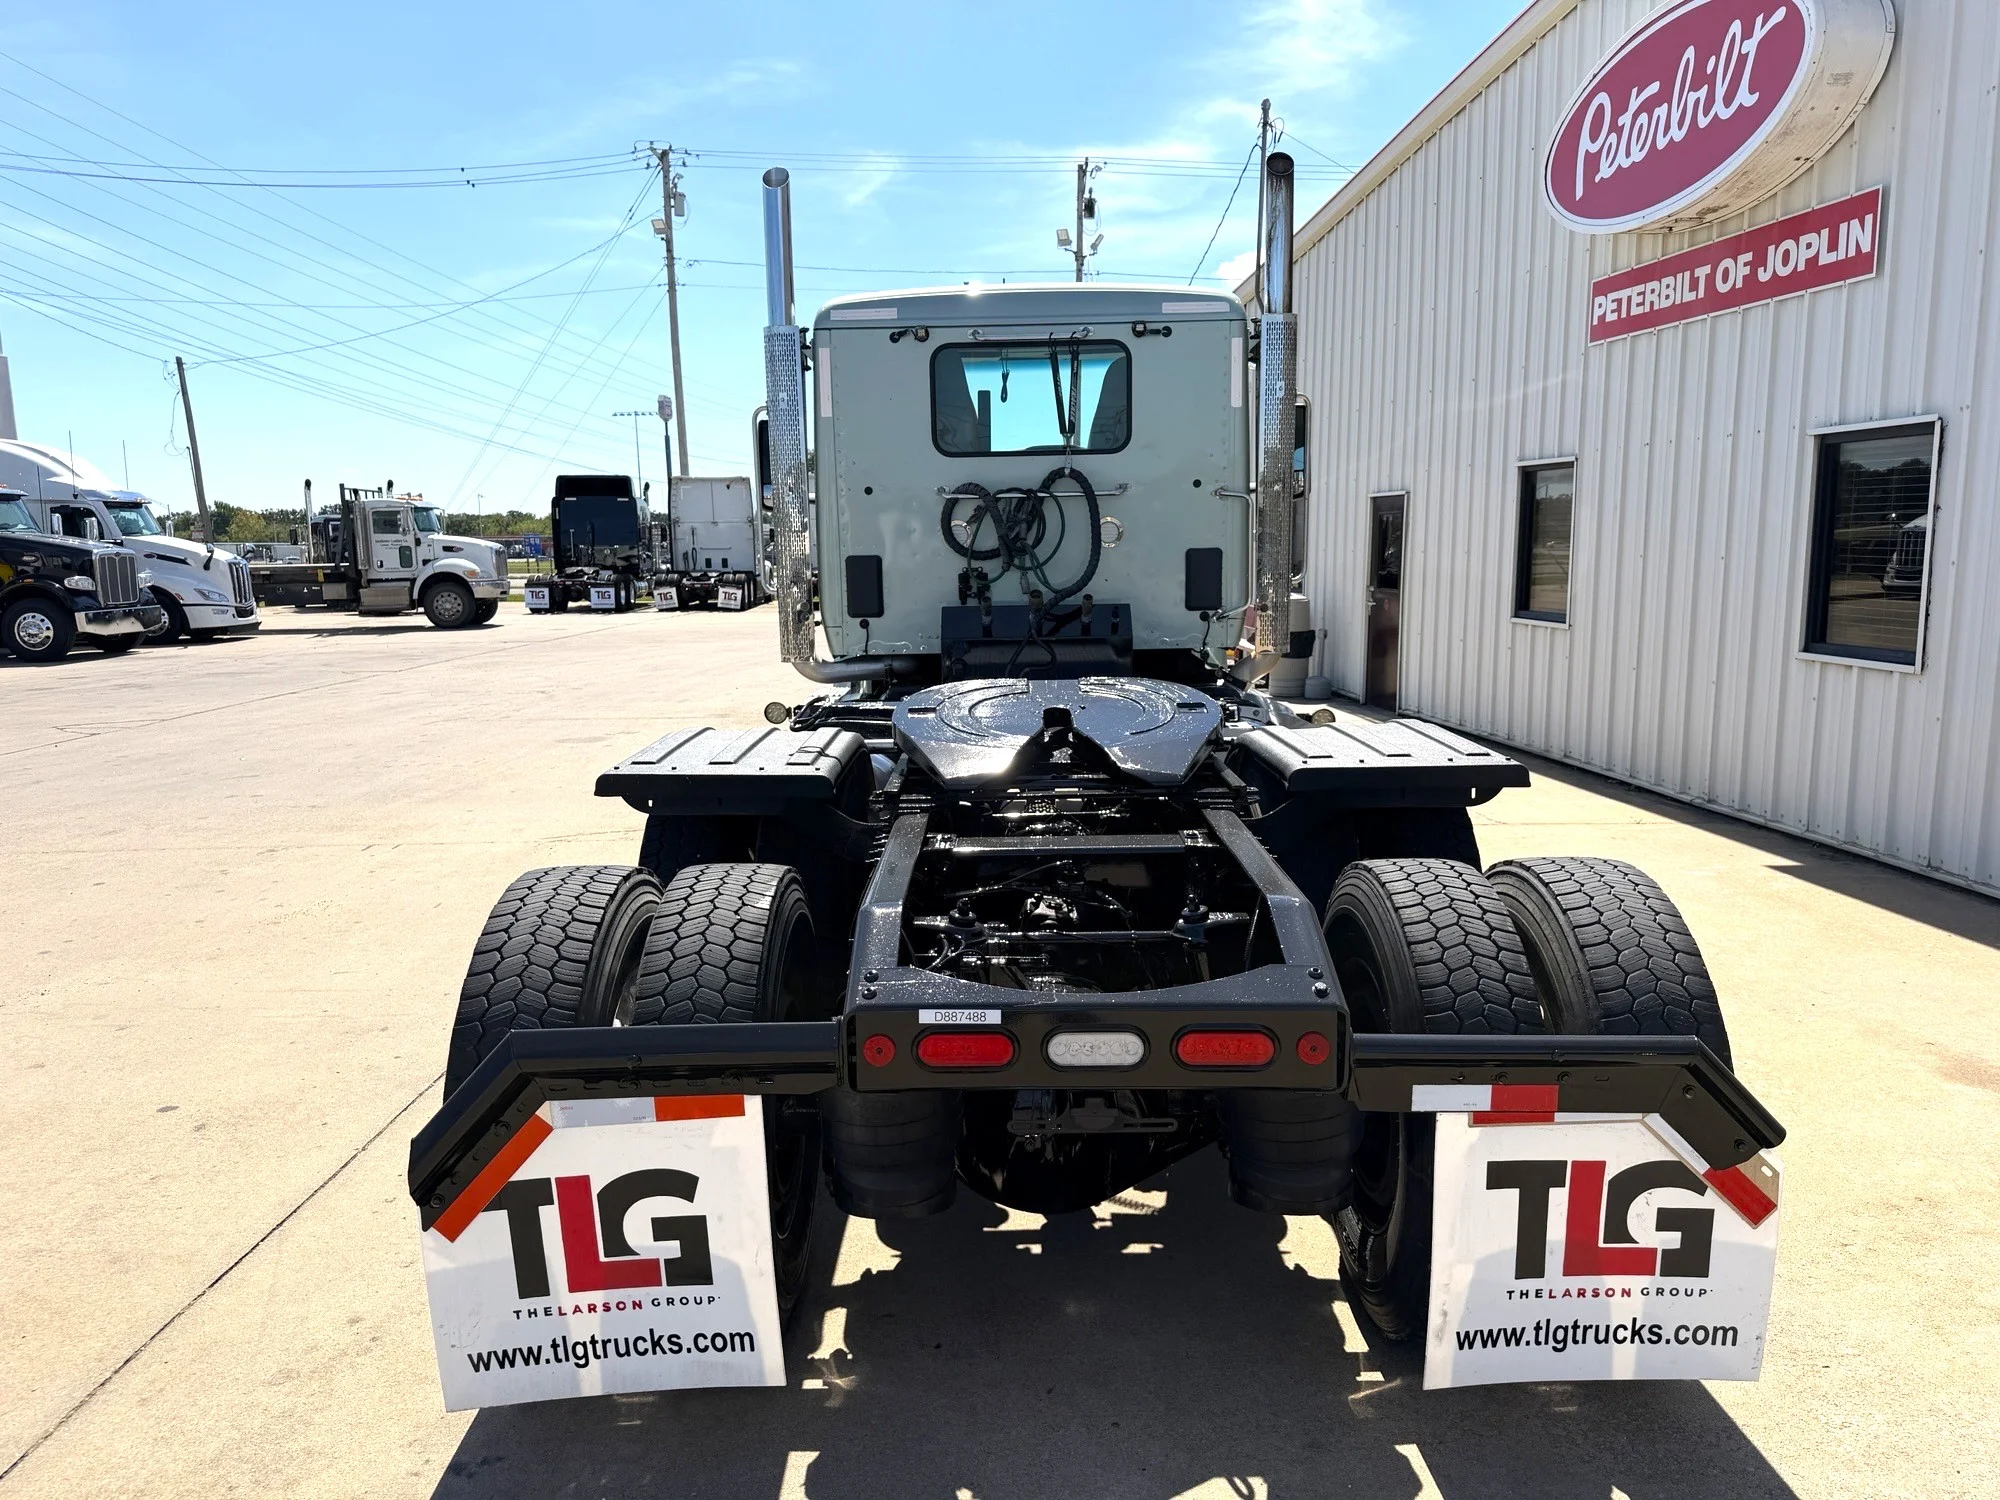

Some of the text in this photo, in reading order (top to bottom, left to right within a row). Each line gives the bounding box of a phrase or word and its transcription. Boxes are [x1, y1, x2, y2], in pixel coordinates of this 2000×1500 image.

[1575, 6, 1786, 201] Peterbilt
[1592, 214, 1873, 326] PETERBILT OF JOPLIN
[529, 590, 545, 599] TLG
[595, 590, 611, 599] TLG
[657, 591, 673, 601] TLG
[722, 591, 738, 601] TLG
[935, 1011, 987, 1022] D887488
[1486, 1160, 1715, 1279] TLG
[481, 1168, 714, 1299] TLG
[1640, 1287, 1708, 1298] GROUP
[651, 1296, 716, 1308] GROUP
[1456, 1317, 1739, 1352] www.tlgtrucks.com
[467, 1328, 756, 1374] www.tlgtrucks.com
